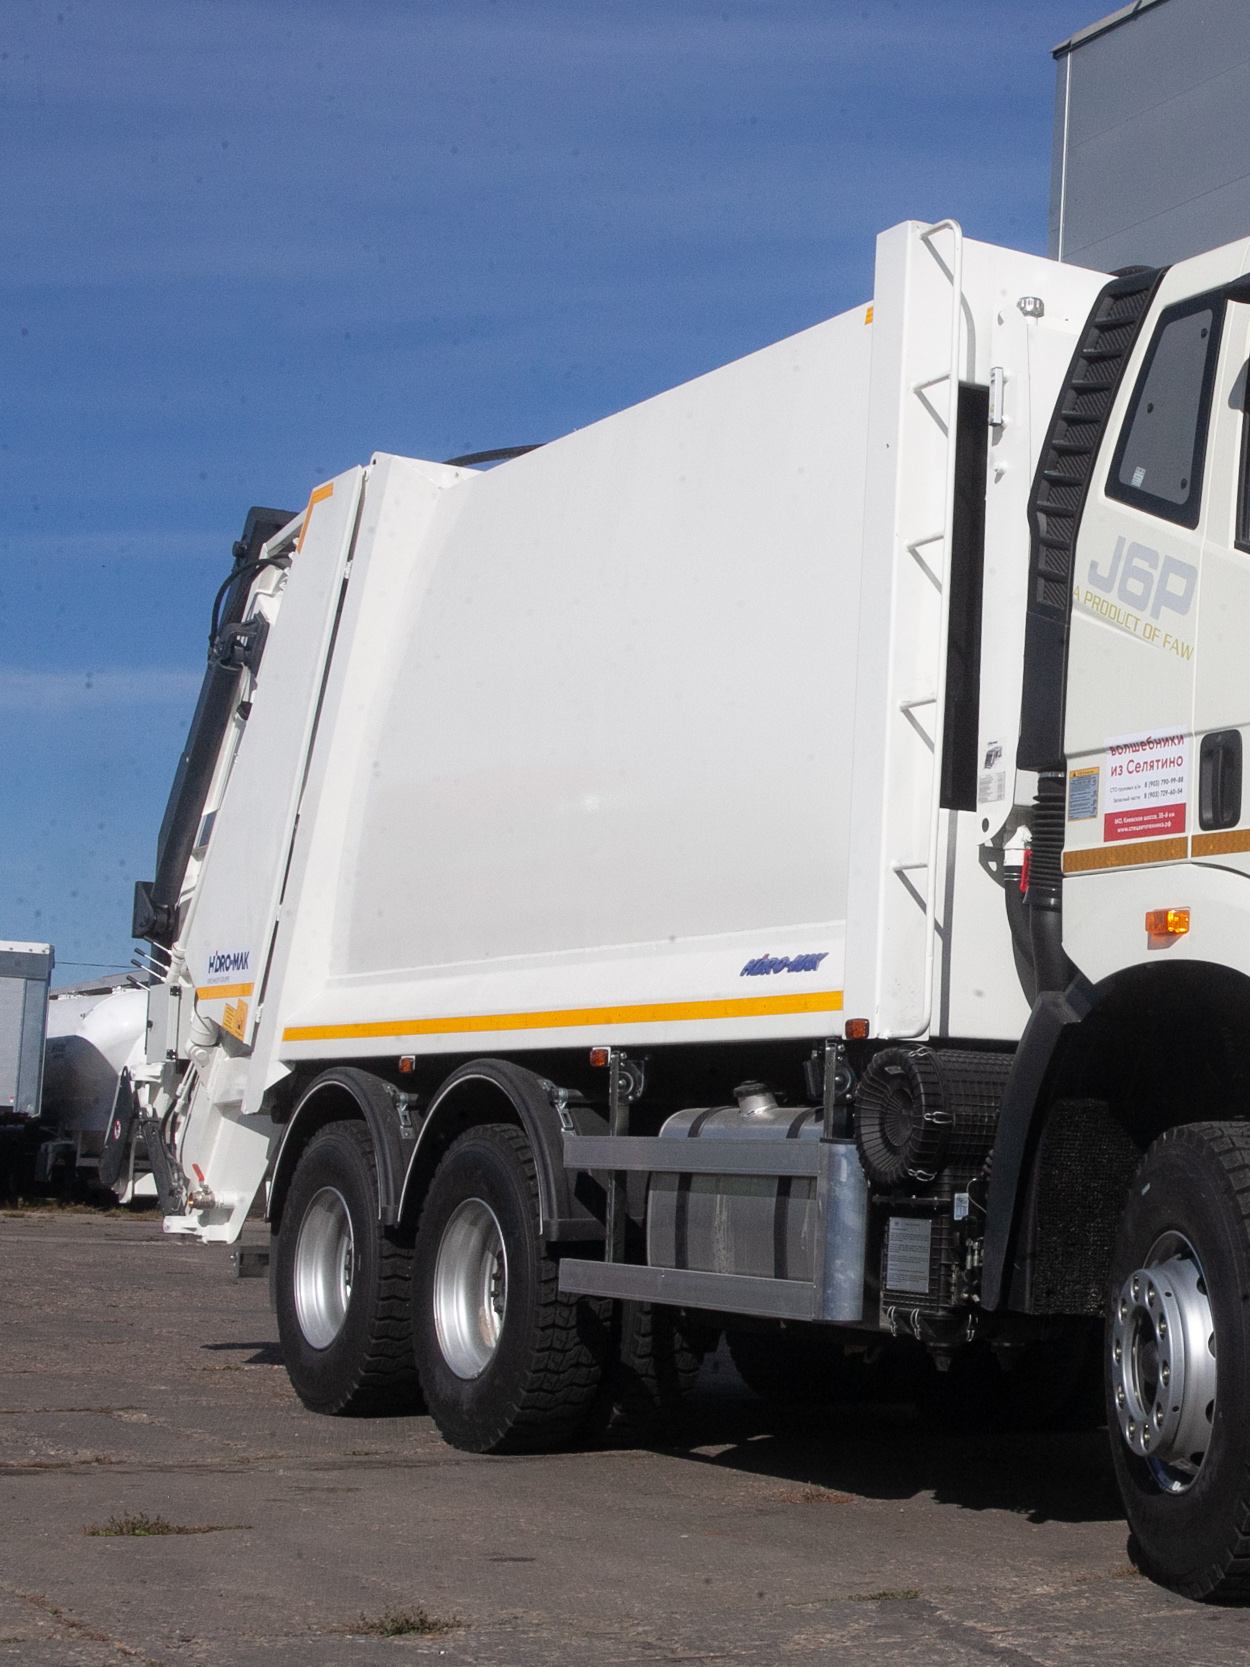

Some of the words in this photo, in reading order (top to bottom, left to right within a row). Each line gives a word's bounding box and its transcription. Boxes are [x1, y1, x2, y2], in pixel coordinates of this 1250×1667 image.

[1087, 535, 1198, 621] J6P
[1083, 590, 1141, 633] PRODUCT
[1142, 622, 1161, 642] OF
[1163, 633, 1194, 661] FAW
[1110, 765, 1124, 778] из
[1126, 755, 1184, 775] Селятино
